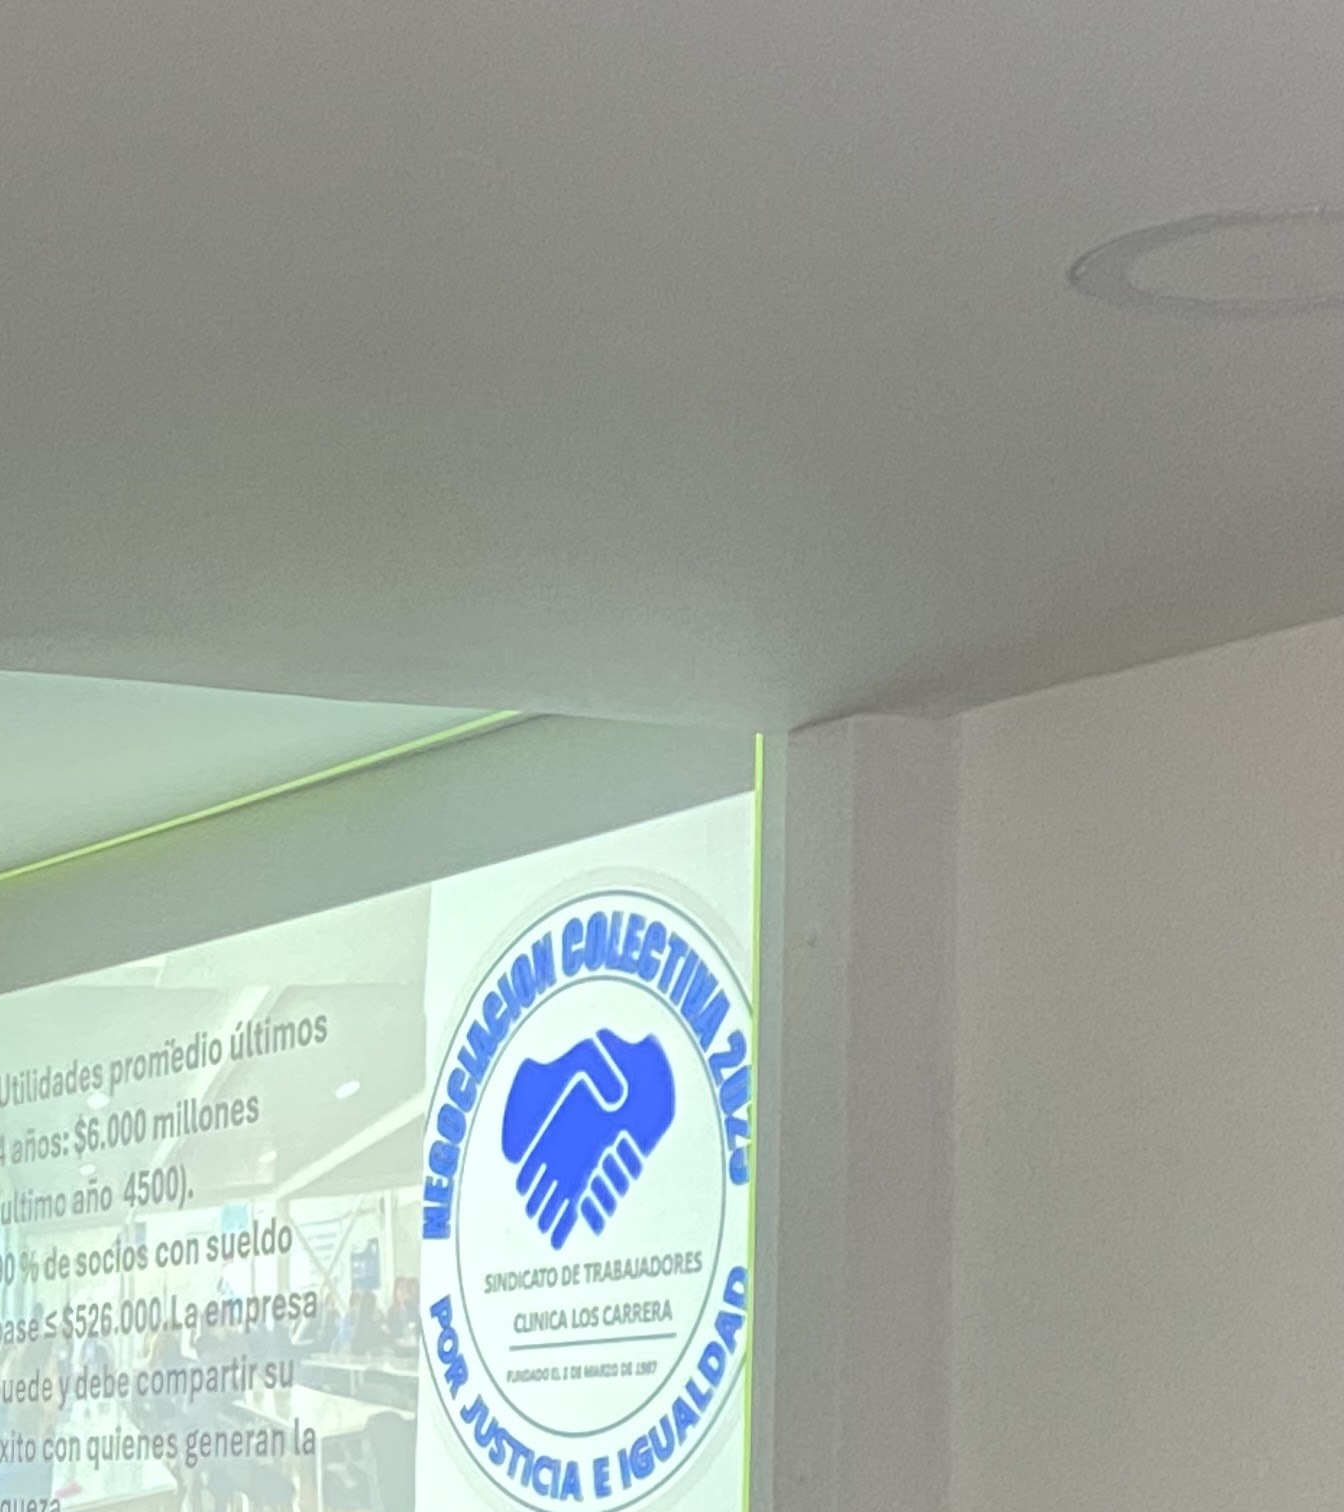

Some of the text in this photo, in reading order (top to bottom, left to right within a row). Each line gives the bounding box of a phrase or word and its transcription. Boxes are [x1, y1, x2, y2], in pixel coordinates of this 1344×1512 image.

[230, 1013, 328, 1061] últimos
[422, 931, 557, 1239] NEGOCIACION
[561, 910, 731, 1052] COLECTIVA
[11, 1128, 69, 1165] años:
[74, 1107, 147, 1160] $6.000
[153, 1094, 260, 1141] millones
[71, 1178, 112, 1216] año
[123, 1163, 195, 1210] 4500).
[44, 1247, 71, 1280] de
[75, 1234, 149, 1278] socios
[155, 1238, 199, 1268] con
[206, 1217, 293, 1261] sueldo
[484, 1250, 703, 1294] SINDICATO DE TRABAJADORES
[205, 1289, 318, 1334] empresa
[513, 1299, 674, 1334] CLINICA LOS CARRERA
[57, 1380, 68, 1411] y
[75, 1364, 129, 1400] debe
[136, 1353, 258, 1404] compartir
[263, 1359, 295, 1390] su
[429, 1265, 749, 1502] POR JUSTICIA E IGUALDAD
[43, 1439, 82, 1464] con
[86, 1426, 178, 1471] quienes
[185, 1428, 286, 1469] generan
[293, 1417, 317, 1457] la
